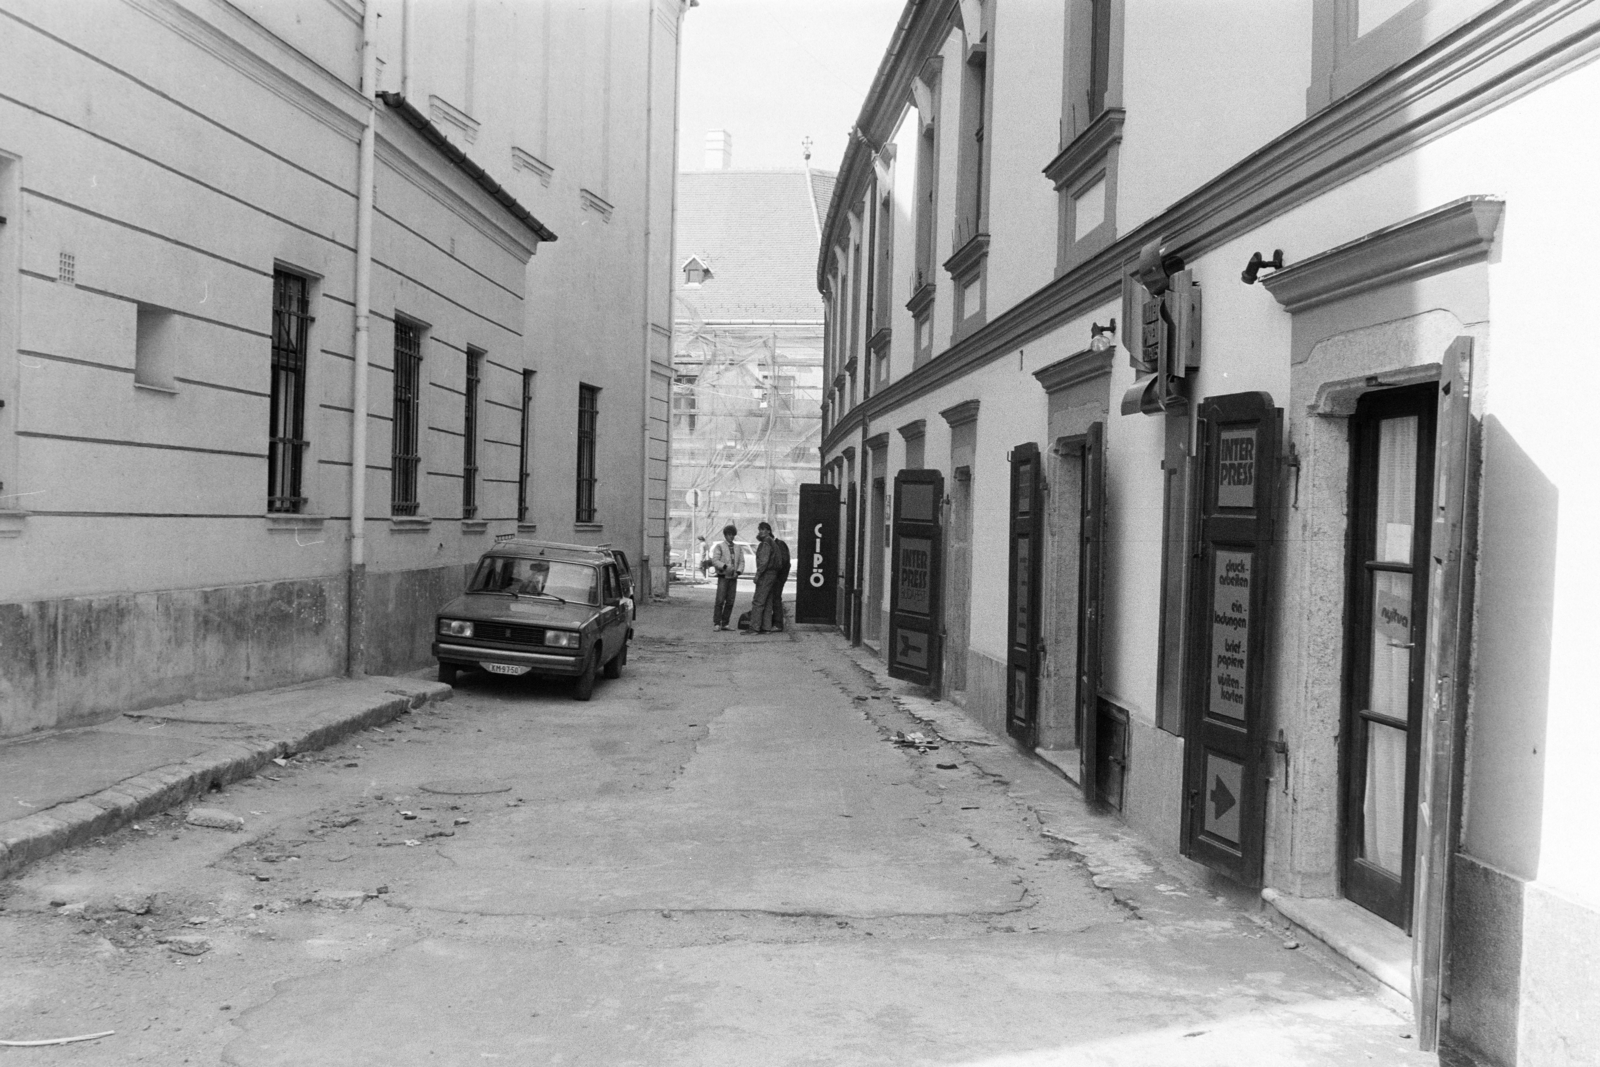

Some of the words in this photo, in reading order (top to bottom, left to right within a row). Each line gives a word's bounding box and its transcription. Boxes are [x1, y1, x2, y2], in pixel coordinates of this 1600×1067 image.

[1221, 437, 1254, 460] INTER
[1220, 462, 1254, 486] PRESS
[902, 548, 928, 569] INTER
[1225, 559, 1249, 573] druck-
[901, 568, 928, 588] PRESS
[1219, 573, 1249, 588] arbeiten
[1213, 610, 1247, 631] ladungen
[1381, 607, 1408, 628] nyitva
[1216, 654, 1245, 670] papiere
[1221, 686, 1244, 705] karten
